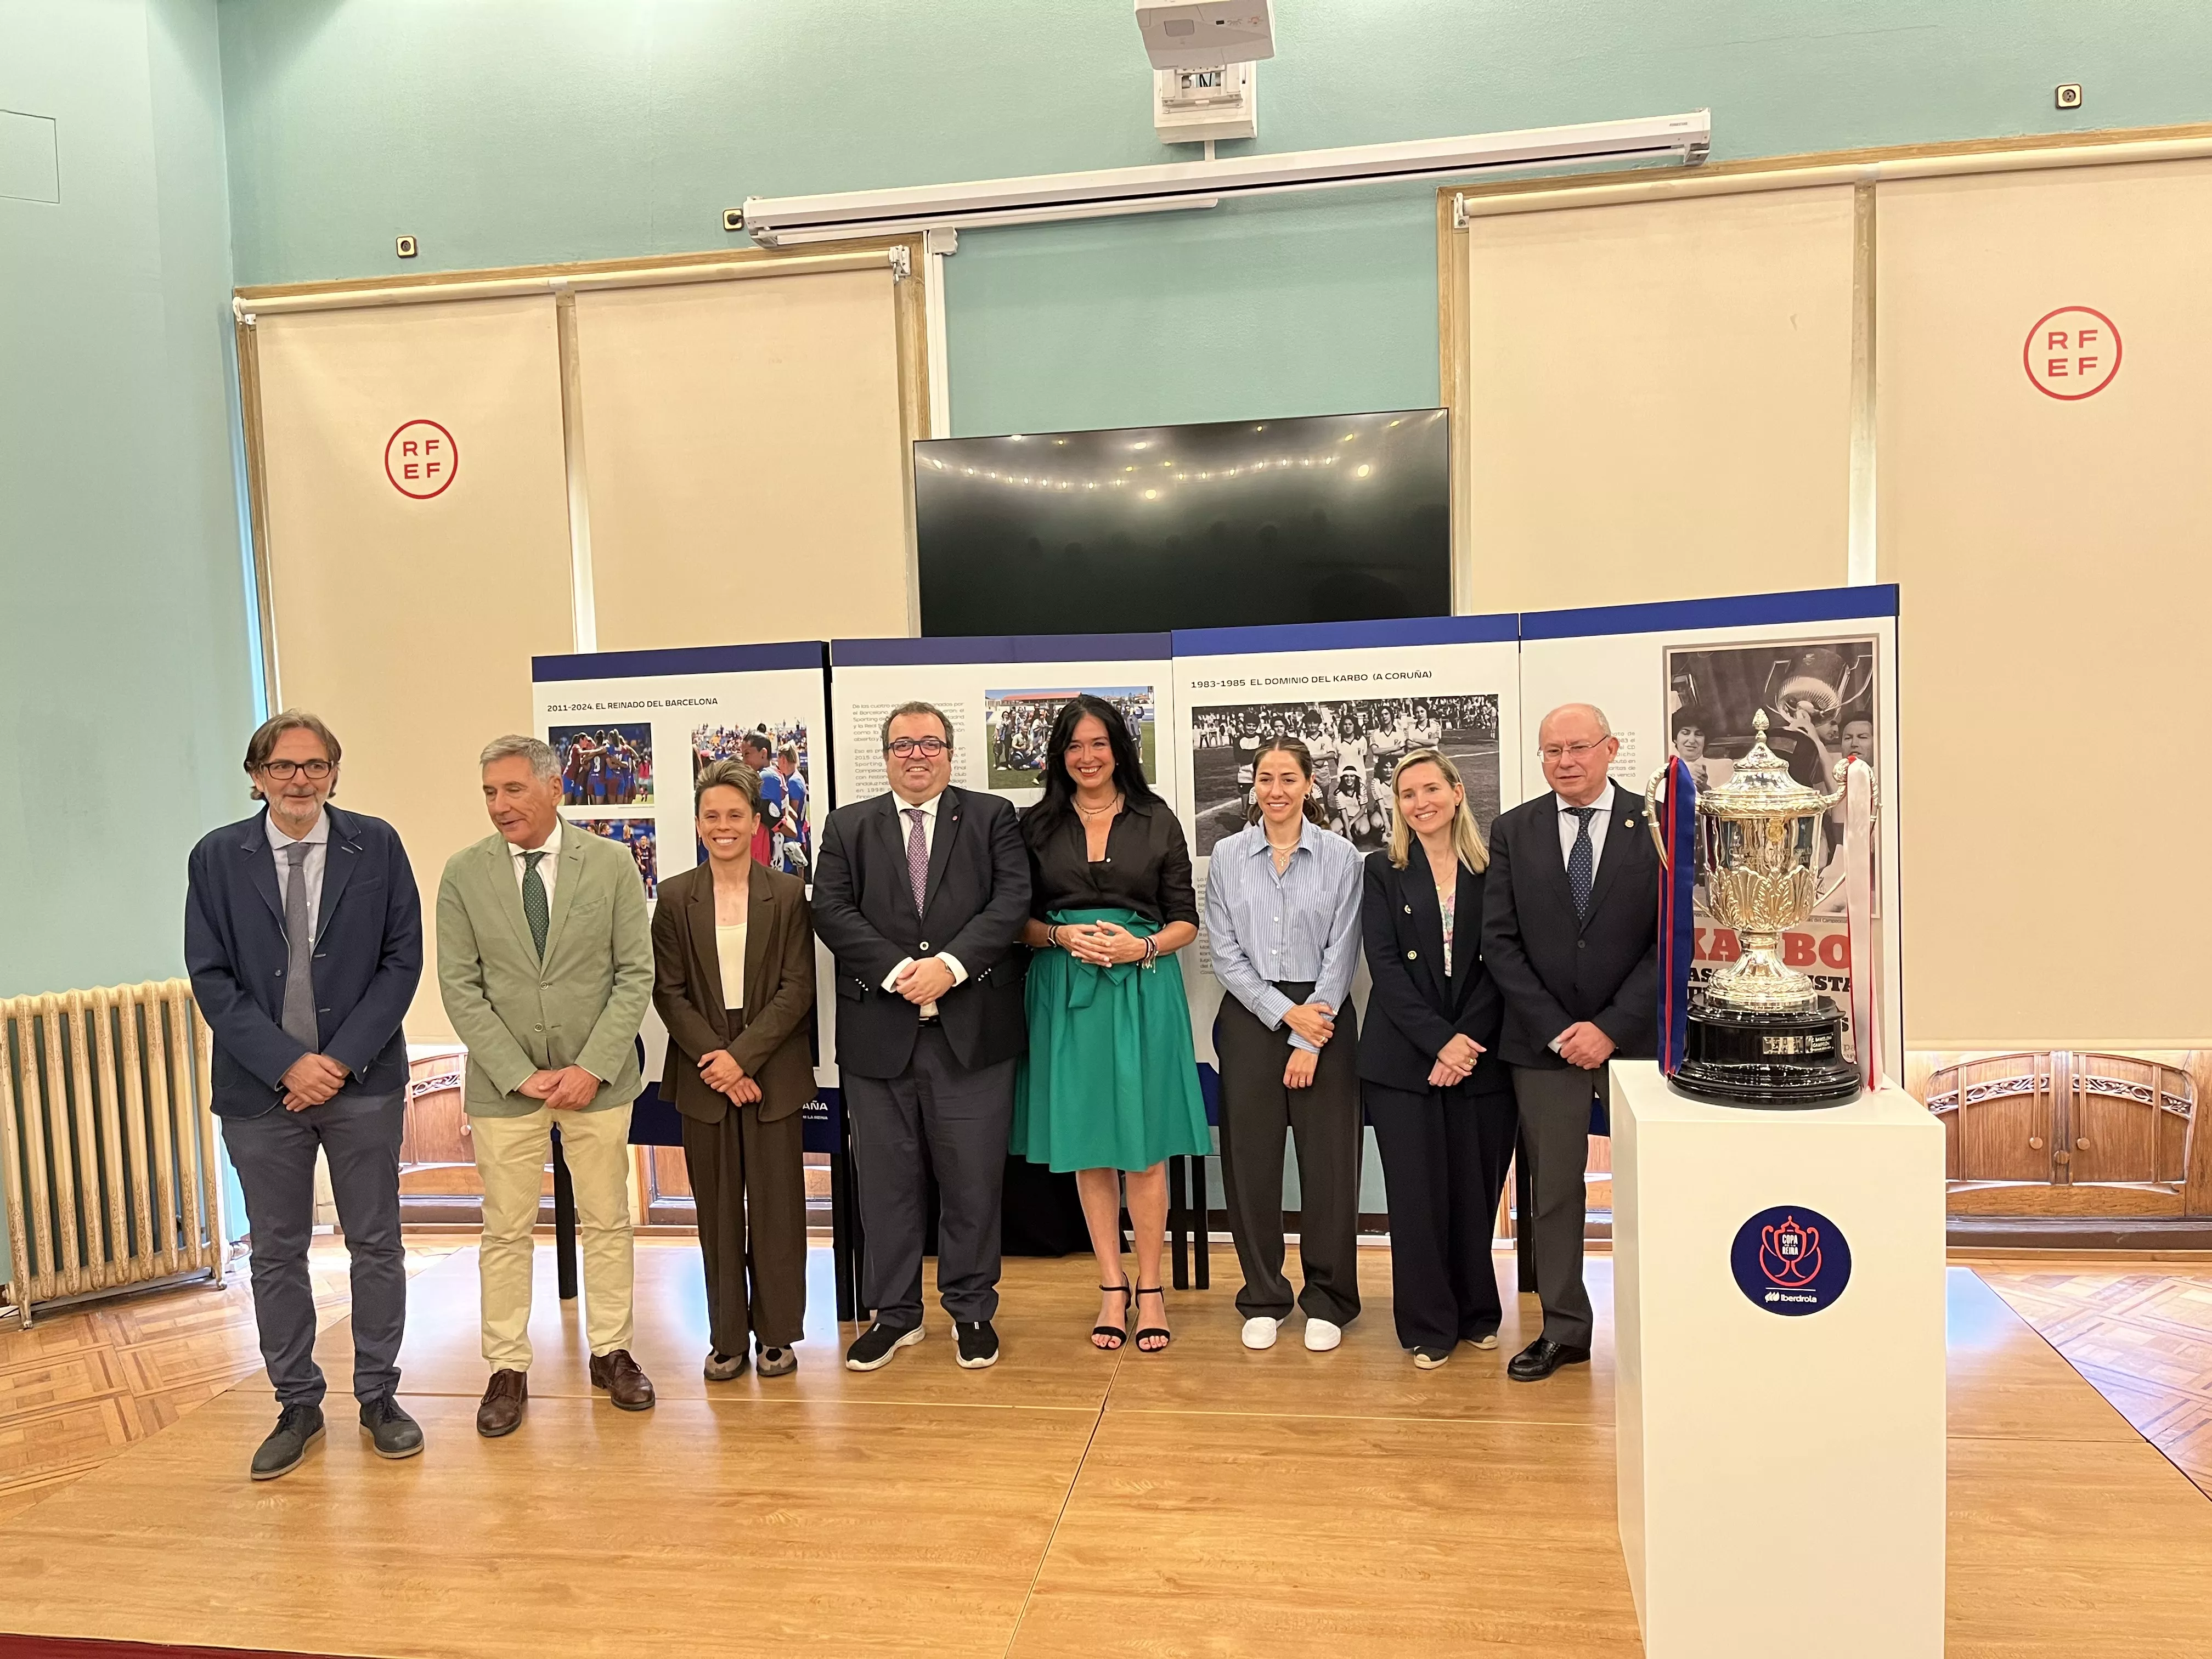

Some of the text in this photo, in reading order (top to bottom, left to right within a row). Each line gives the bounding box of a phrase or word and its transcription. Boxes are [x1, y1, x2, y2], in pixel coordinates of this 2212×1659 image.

[1191, 679, 1245, 688] 1983-1985
[1265, 676, 1308, 685] DOMINIO
[1385, 670, 1432, 680] CORUÑA)
[548, 703, 594, 712] 2011-2024.
[608, 701, 645, 709] REINADO
[665, 698, 718, 707] BARCELONA
[1782, 1234, 1798, 1244] COPA
[1782, 1246, 1798, 1255] REINA
[1781, 1294, 1817, 1303] Iberdrola
